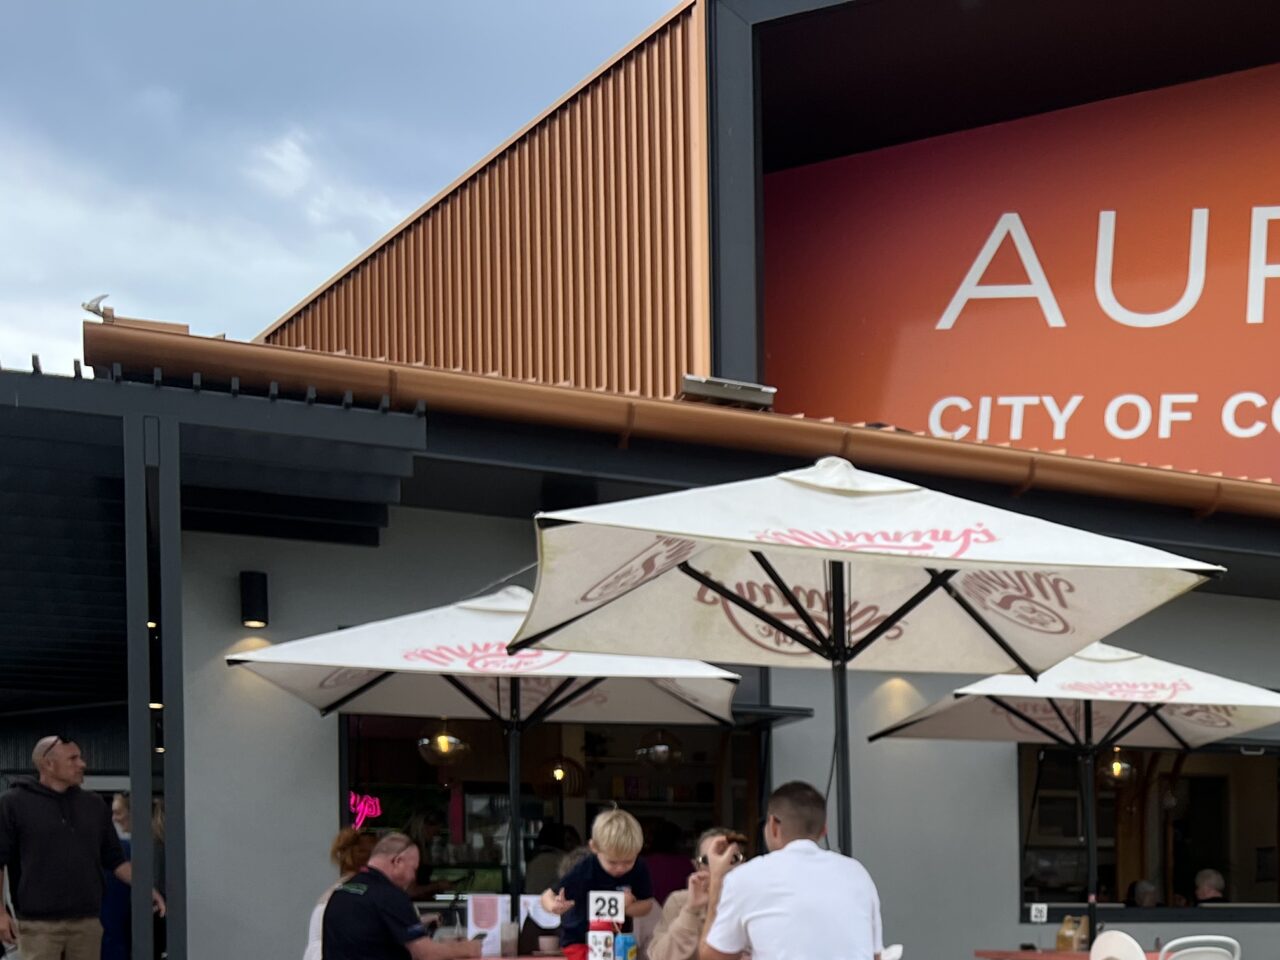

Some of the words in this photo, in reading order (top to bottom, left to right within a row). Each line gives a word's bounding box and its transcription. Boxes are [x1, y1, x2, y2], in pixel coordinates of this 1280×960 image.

[927, 395, 1084, 440] CITY
[1103, 393, 1199, 439] OF
[595, 897, 619, 917] 28
